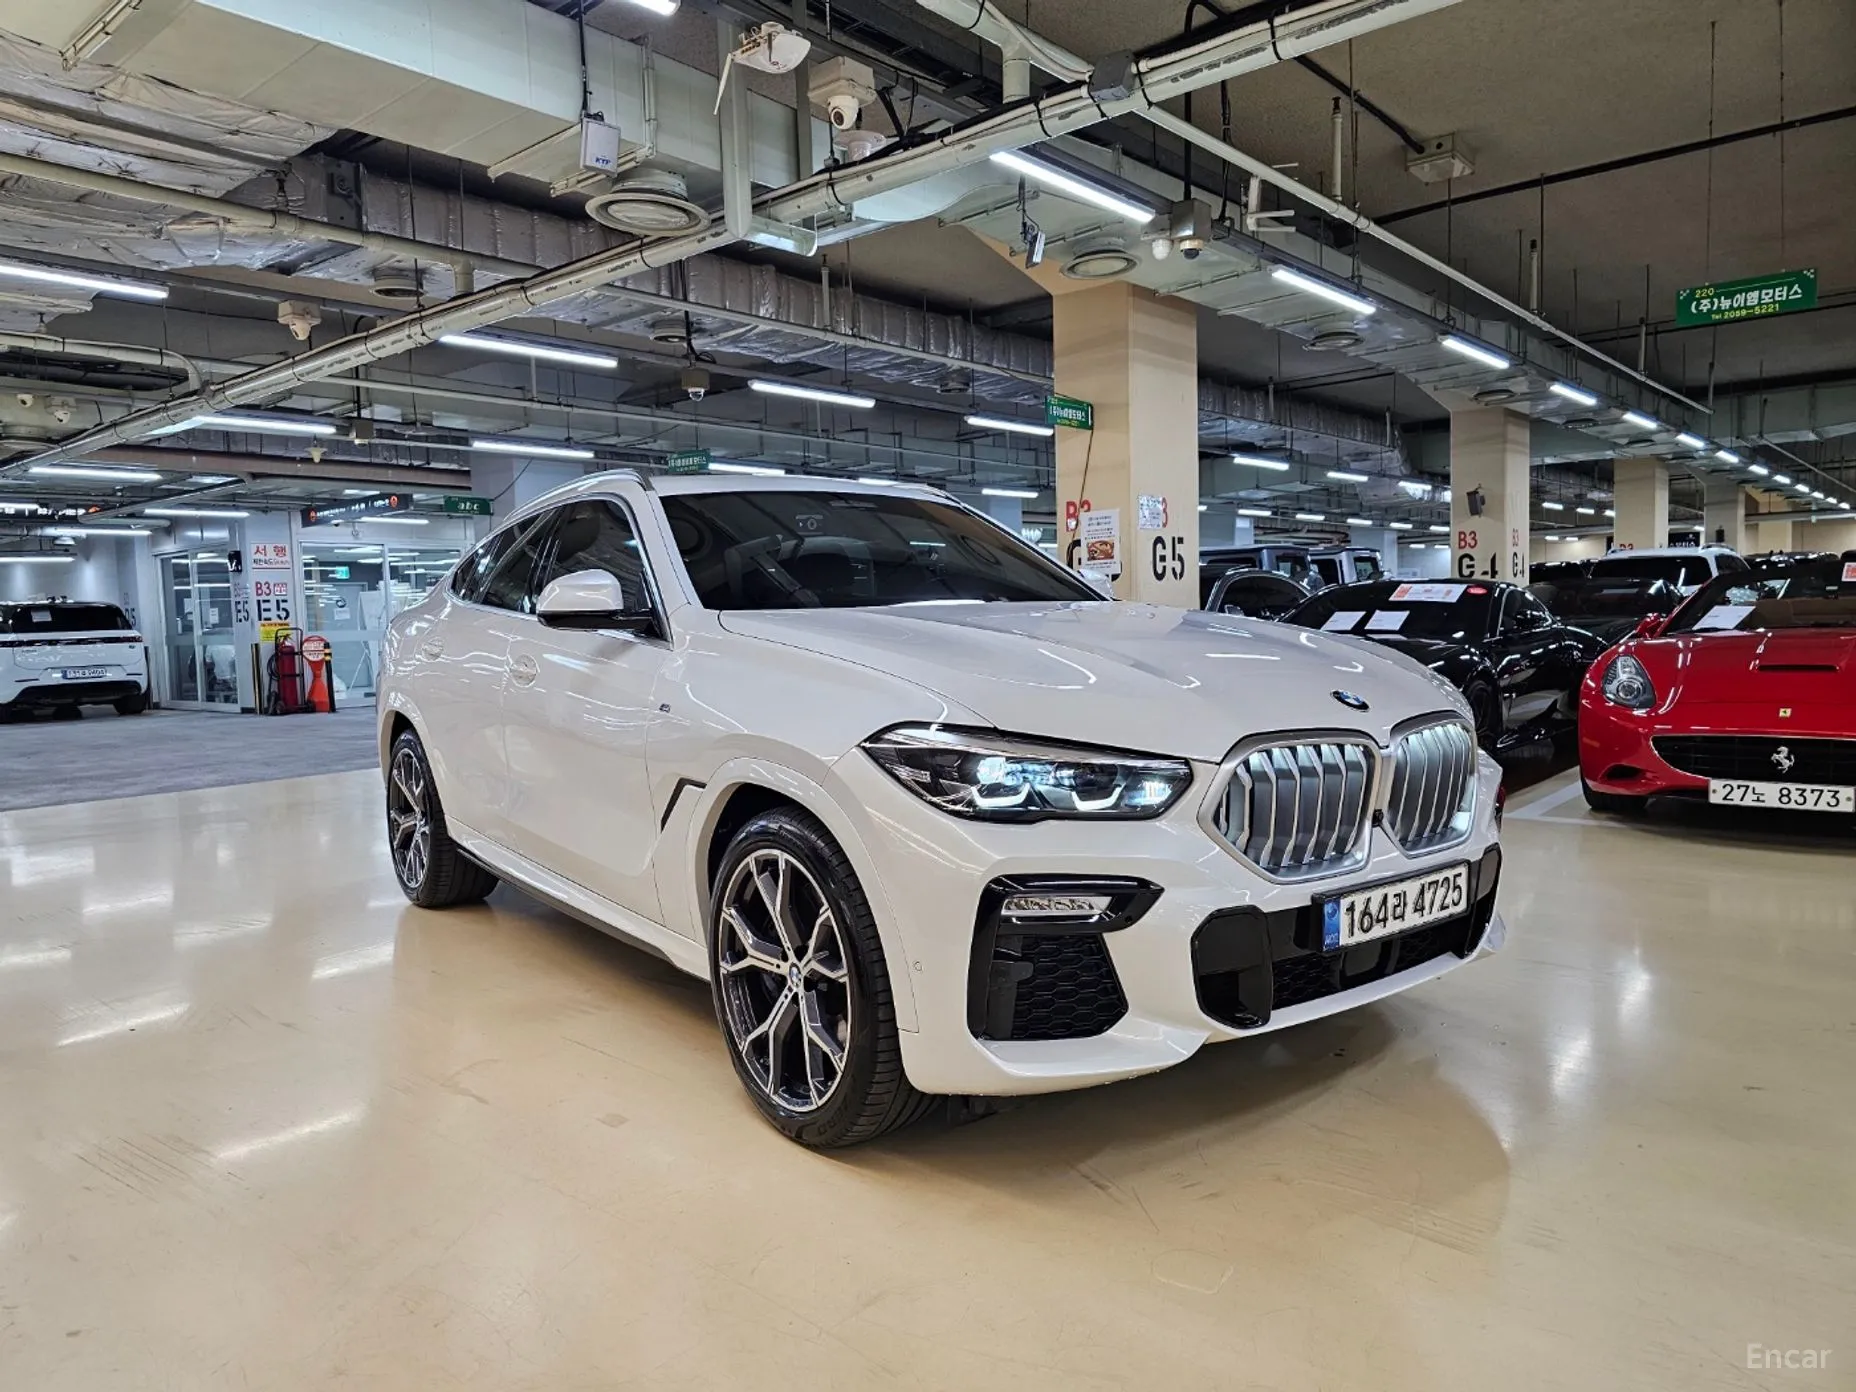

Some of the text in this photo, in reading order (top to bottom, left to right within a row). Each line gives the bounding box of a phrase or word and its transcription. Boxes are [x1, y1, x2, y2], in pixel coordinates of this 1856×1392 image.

[1695, 287, 1715, 298] 220
[1711, 303, 1780, 321] Tel 2059-5221
[457, 501, 480, 510] abc
[1457, 530, 1478, 549] B3
[1152, 536, 1185, 581] G5
[255, 581, 271, 597] B3
[256, 599, 290, 622] E5
[1722, 783, 1840, 808] 27노 8373
[1346, 872, 1462, 938] 164라 4725
